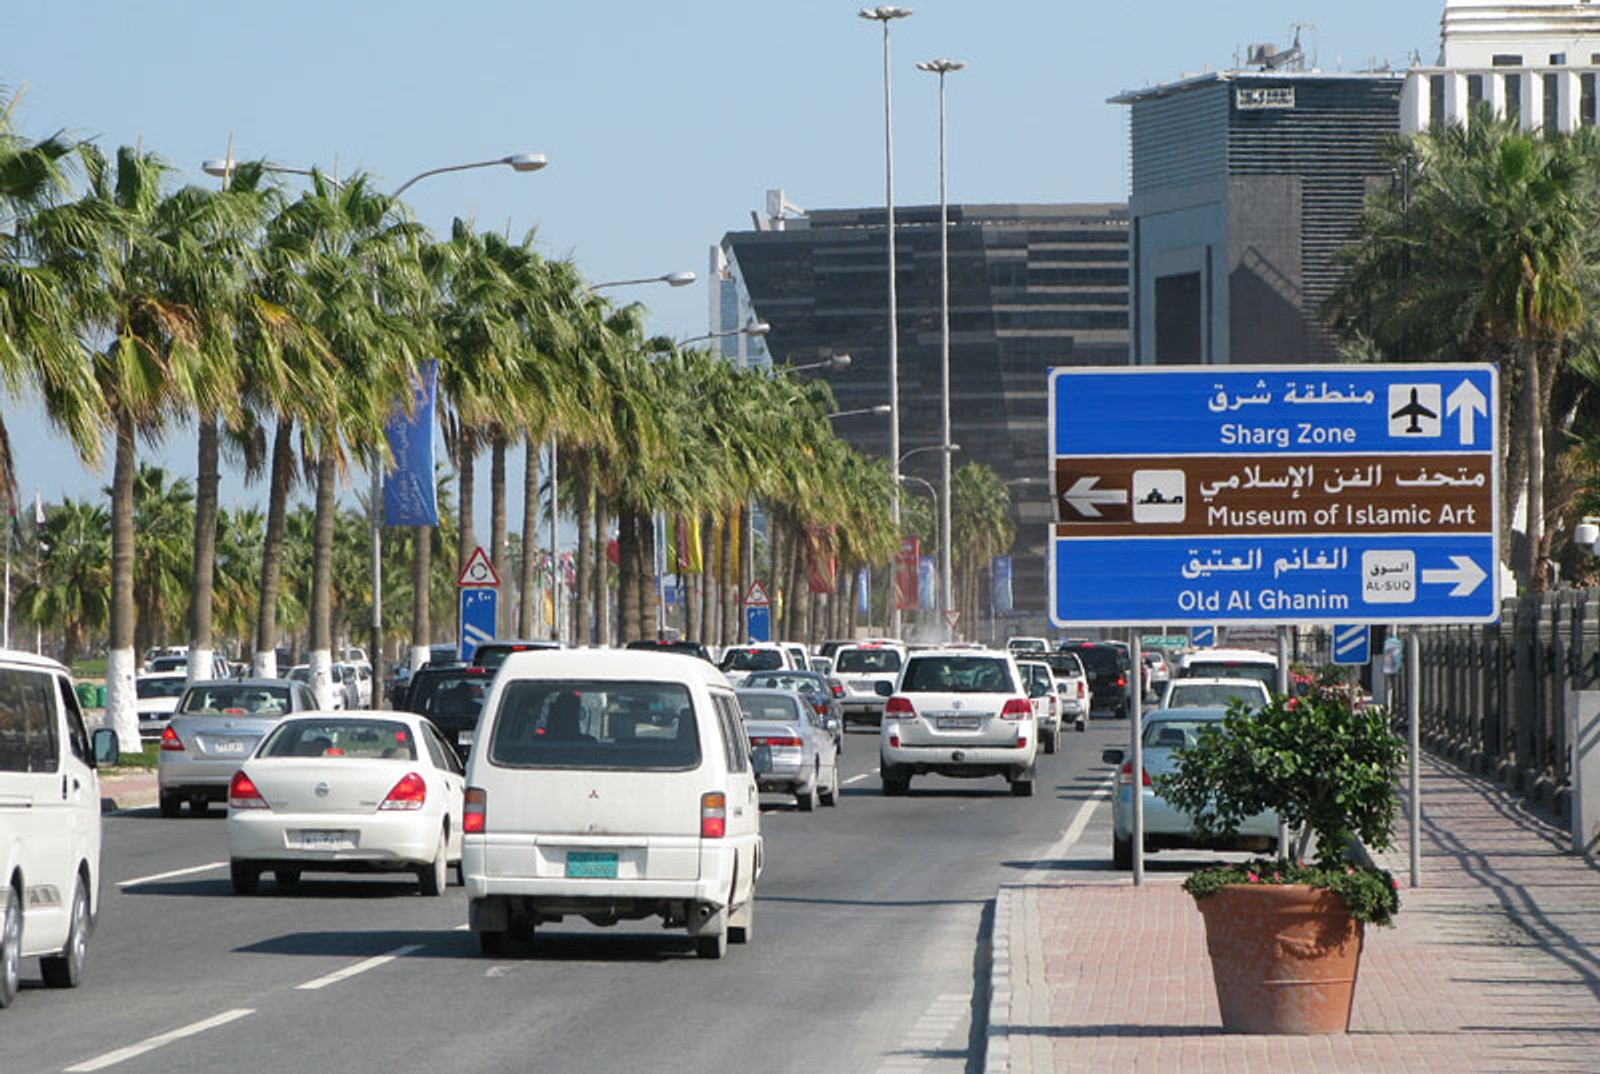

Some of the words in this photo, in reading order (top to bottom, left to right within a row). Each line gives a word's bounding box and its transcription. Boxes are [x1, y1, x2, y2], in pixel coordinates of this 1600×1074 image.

[1208, 379, 1271, 412] شرق
[1284, 381, 1375, 404] منطقة
[1220, 424, 1290, 448] Sharg
[1297, 423, 1357, 444] Zone
[1199, 464, 1314, 502] الإسلامي
[1323, 464, 1382, 493] الفن
[1396, 467, 1485, 488] متحف
[1207, 505, 1307, 527] Museum
[1313, 503, 1340, 526] of
[1347, 503, 1431, 525] Islamic
[1438, 503, 1476, 525] Art
[1181, 547, 1262, 579] العتيق
[1274, 546, 1348, 579] الغانم
[1370, 562, 1409, 577] السوق
[1366, 580, 1411, 592] AL-SUQ
[1177, 590, 1220, 611] Old
[1227, 590, 1253, 611] Al
[1258, 588, 1349, 610] Ghanim
